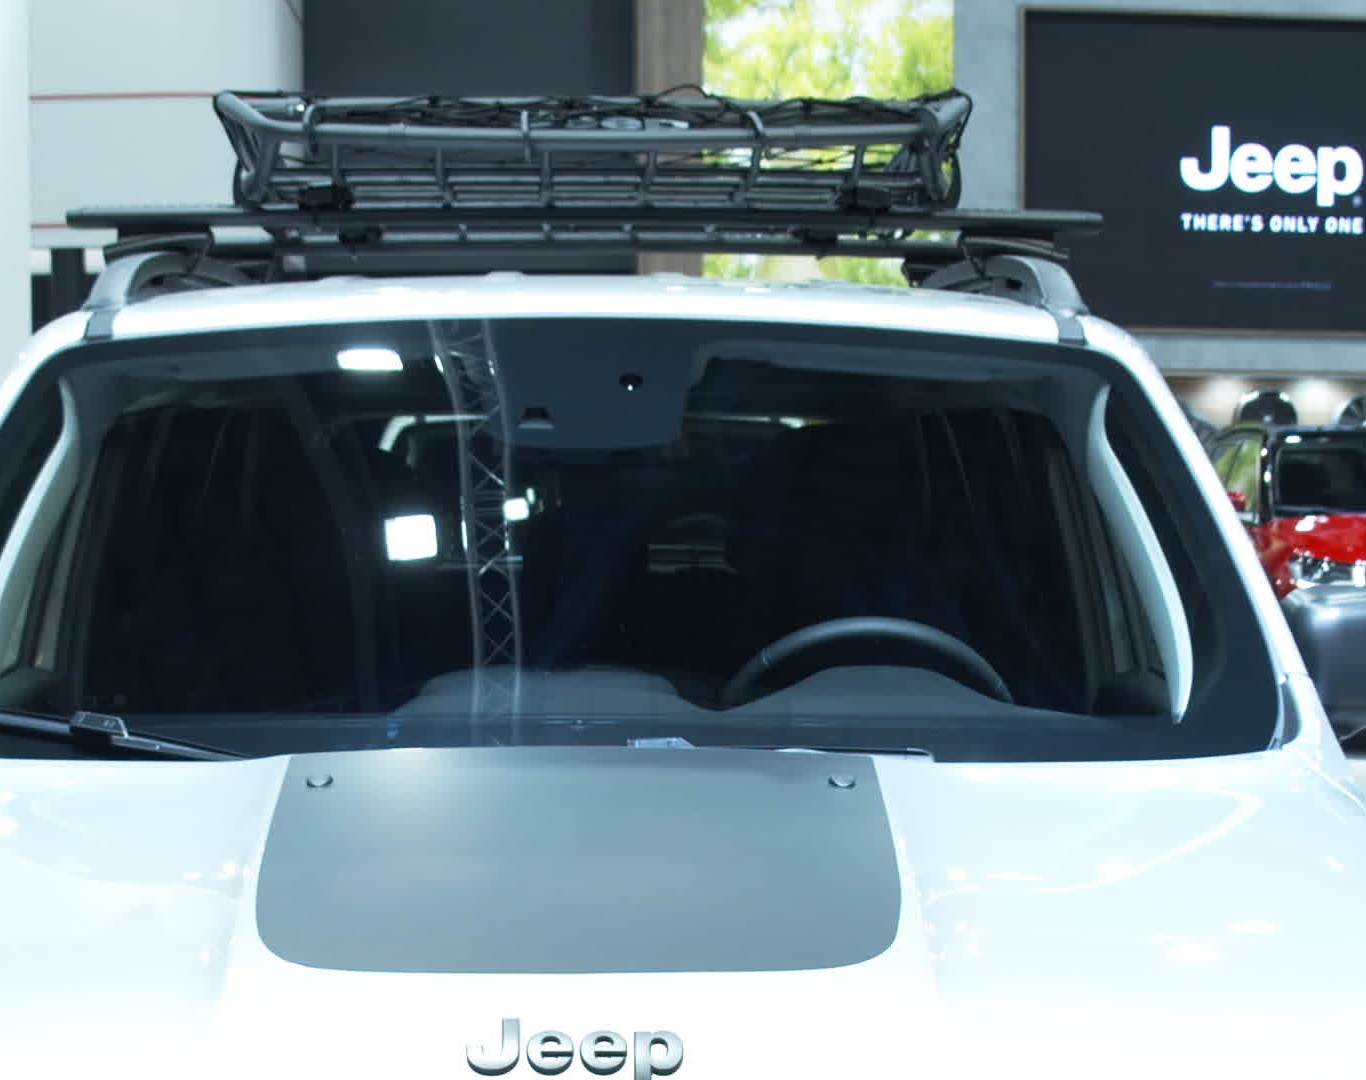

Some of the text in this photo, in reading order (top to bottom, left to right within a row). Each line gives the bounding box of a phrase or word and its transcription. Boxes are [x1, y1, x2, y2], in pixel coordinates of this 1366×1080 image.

[1179, 124, 1364, 207] Jeep
[1180, 212, 1364, 235] THERE'S ONLY ONE
